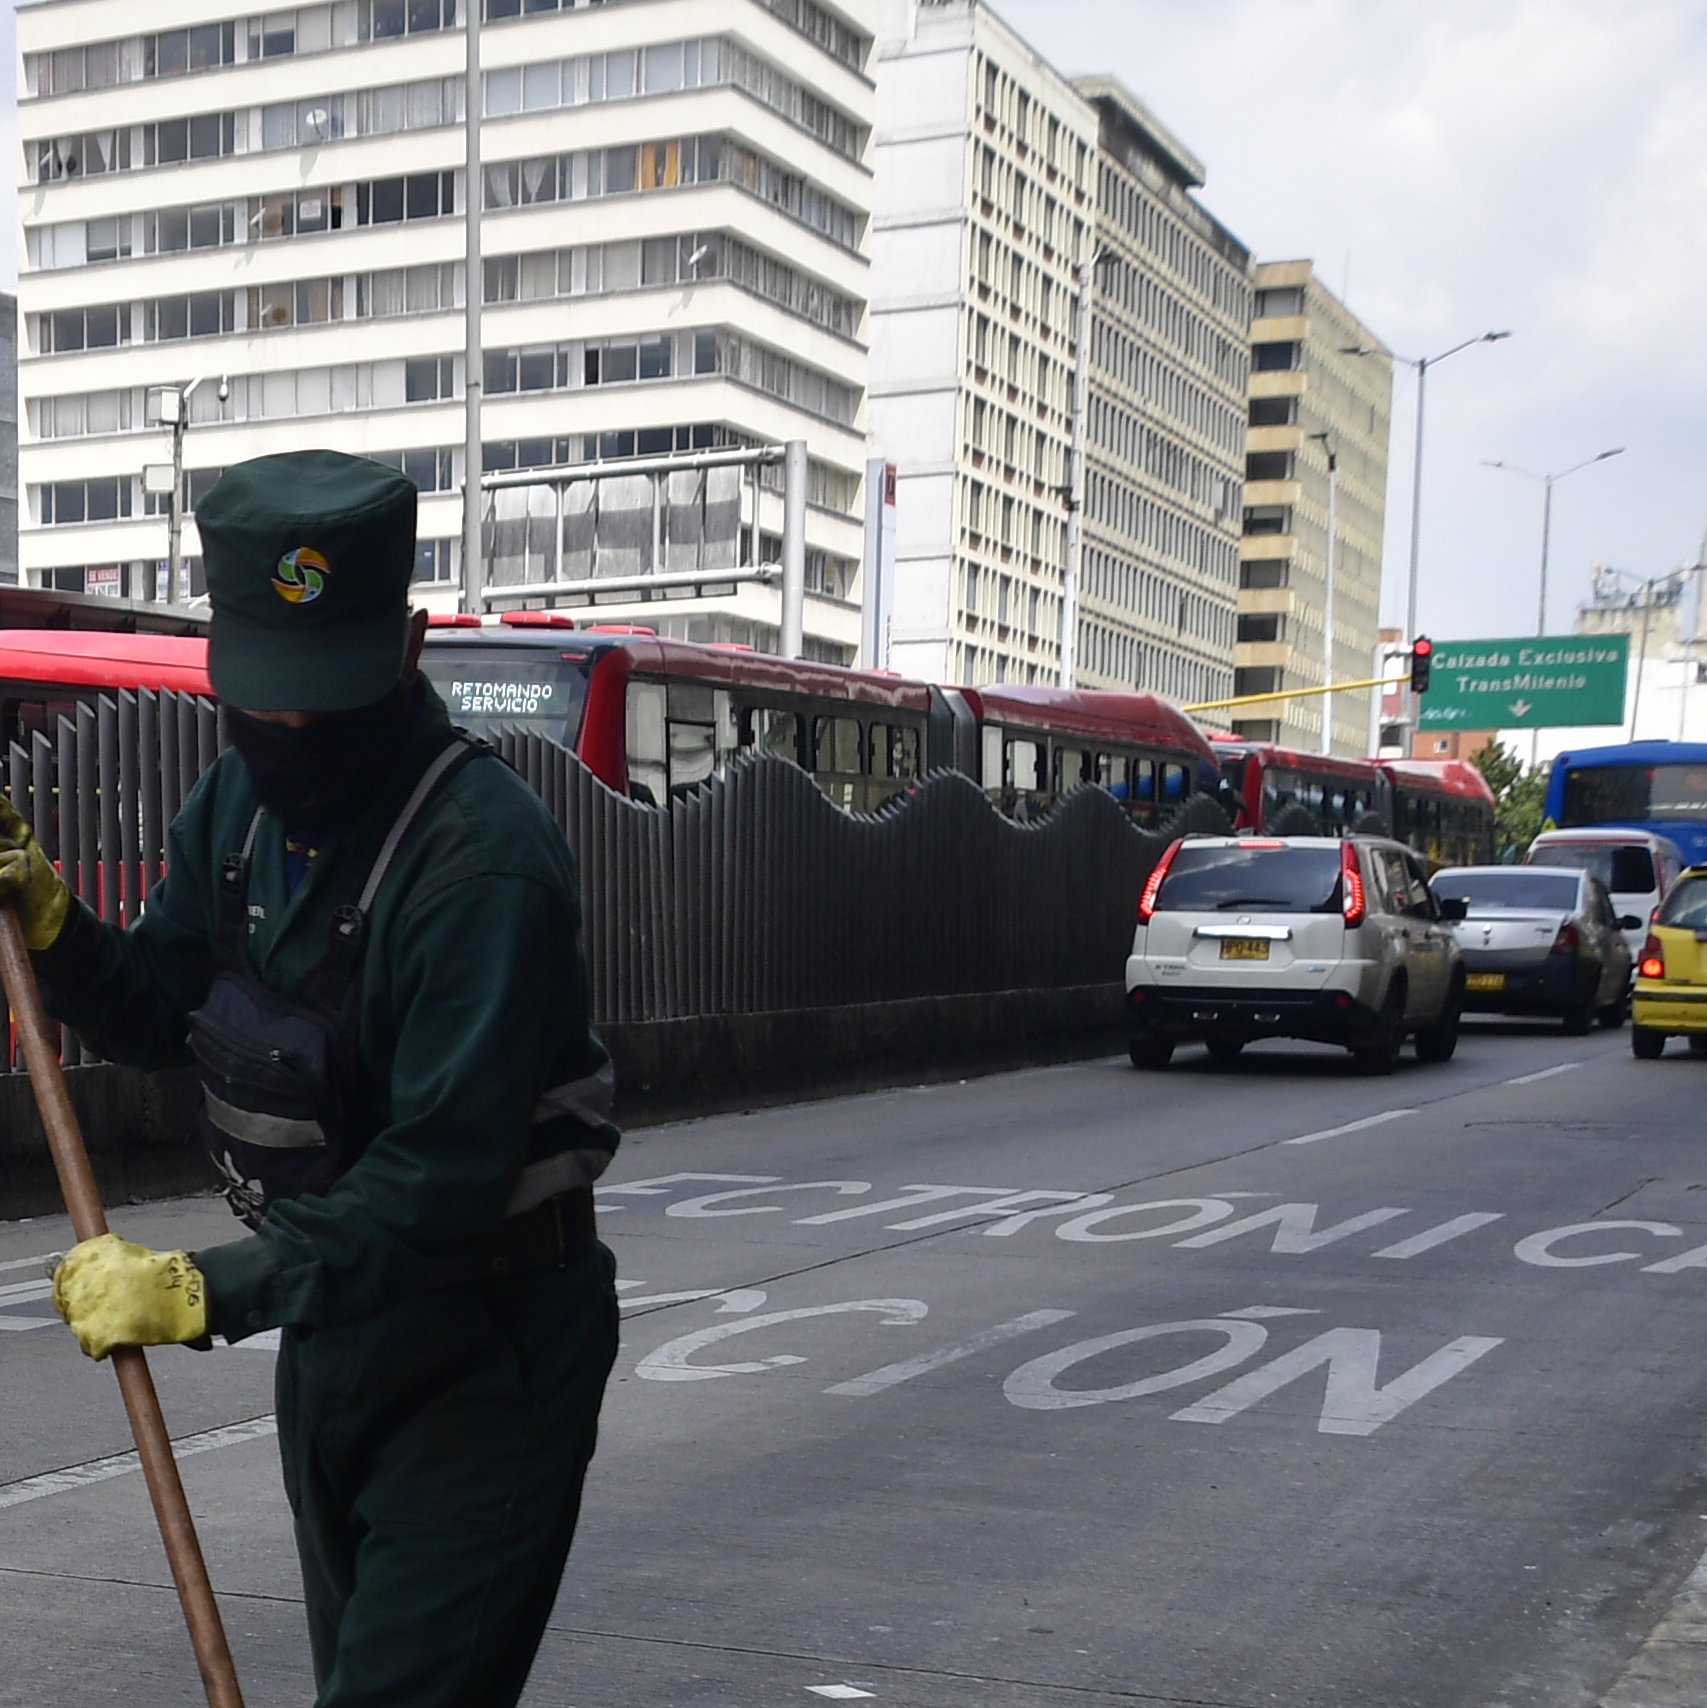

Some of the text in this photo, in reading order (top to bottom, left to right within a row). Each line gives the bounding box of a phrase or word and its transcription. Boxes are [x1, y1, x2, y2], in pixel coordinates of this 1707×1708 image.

[1431, 647, 1619, 670] Calzada Exclusiva
[451, 681, 553, 700] RETOMANDO
[1456, 673, 1587, 693] TransMilenio
[461, 696, 538, 713] SERVICIO
